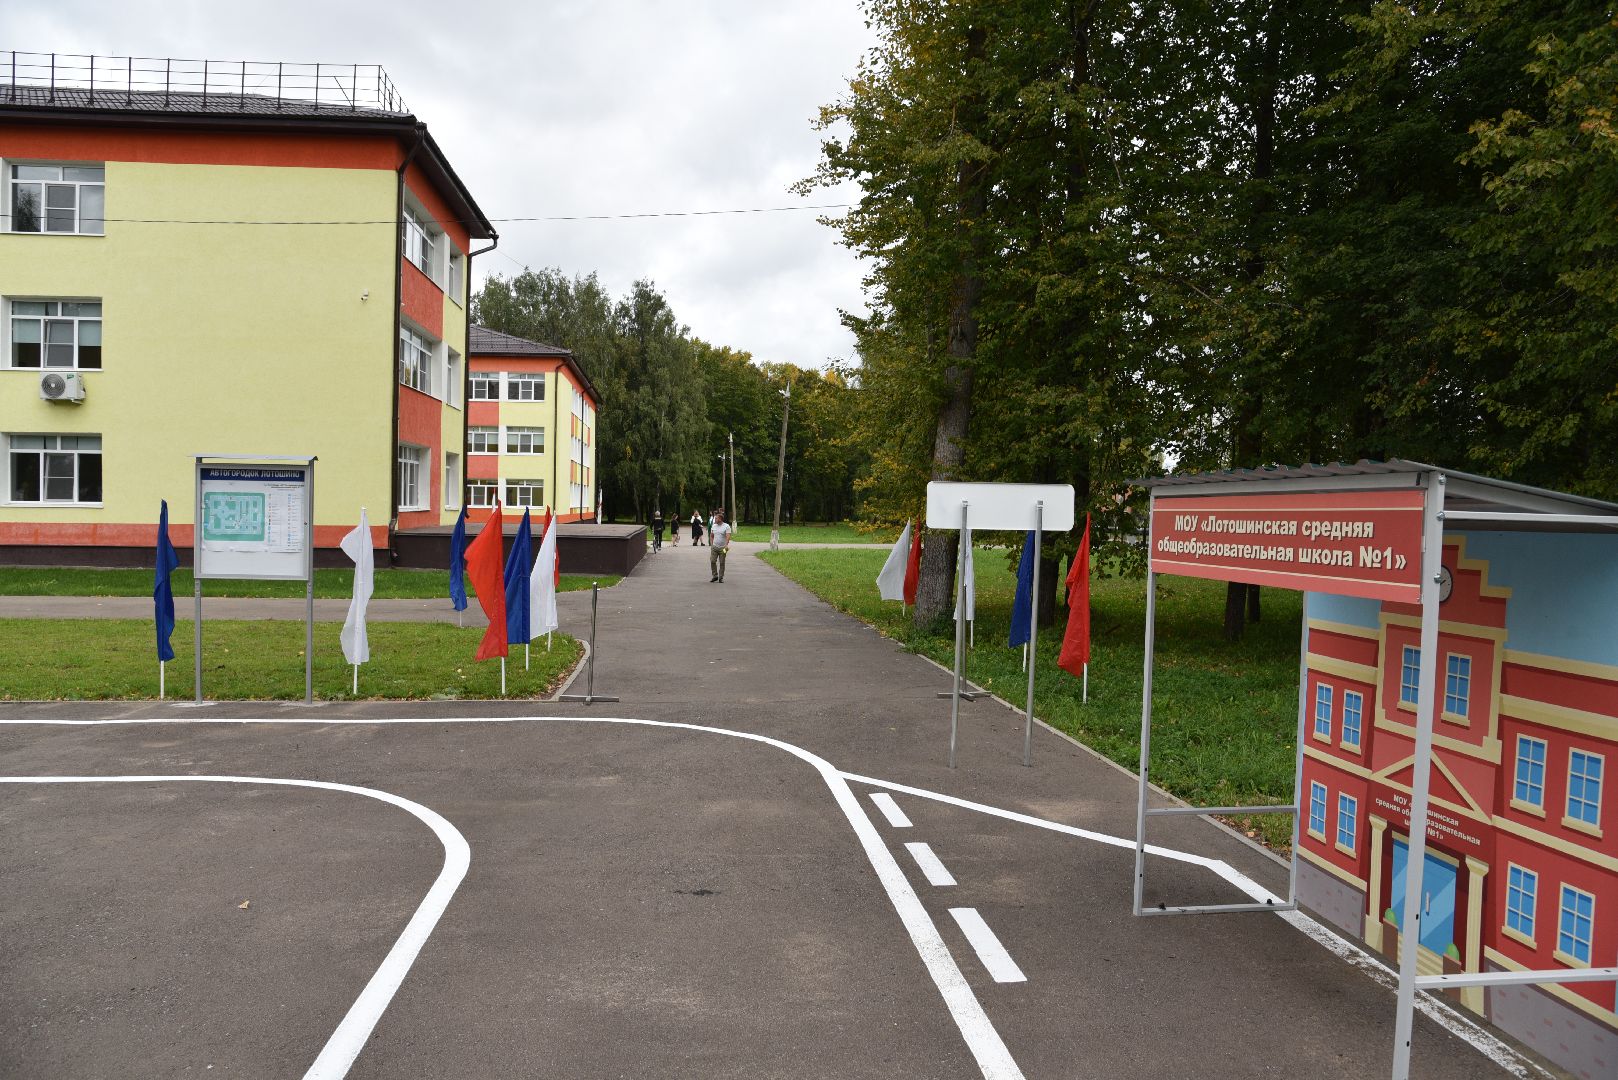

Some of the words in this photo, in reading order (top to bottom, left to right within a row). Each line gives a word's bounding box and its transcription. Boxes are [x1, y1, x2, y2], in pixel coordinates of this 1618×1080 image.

[1174, 515, 1199, 531] МОУ
[1201, 515, 1298, 536] «Лотошинская
[1301, 520, 1374, 541] средняя
[1157, 536, 1294, 562] общеобразовательная
[1298, 547, 1354, 567] школа
[1359, 545, 1407, 570] №1»
[1375, 797, 1401, 813] средняя
[1393, 794, 1408, 806] МОУ
